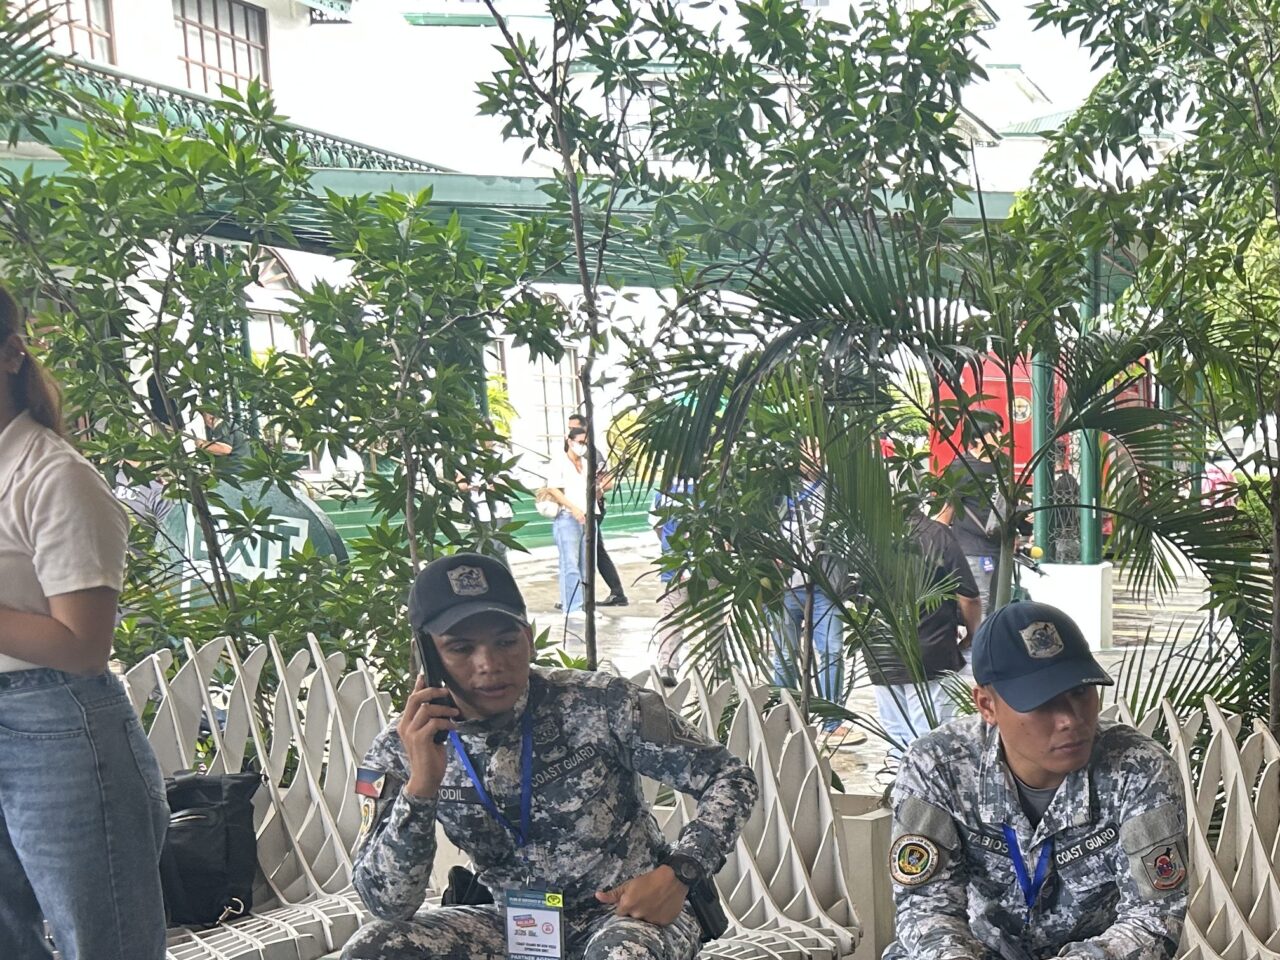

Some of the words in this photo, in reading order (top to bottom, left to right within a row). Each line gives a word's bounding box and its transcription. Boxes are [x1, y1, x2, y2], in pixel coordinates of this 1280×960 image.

[531, 763, 562, 787] COAST
[563, 746, 596, 770] GUARD
[438, 788, 466, 801] ODIL
[966, 831, 1009, 853] TABIOS
[1056, 845, 1083, 865] COAST
[1085, 827, 1116, 851] GUARD
